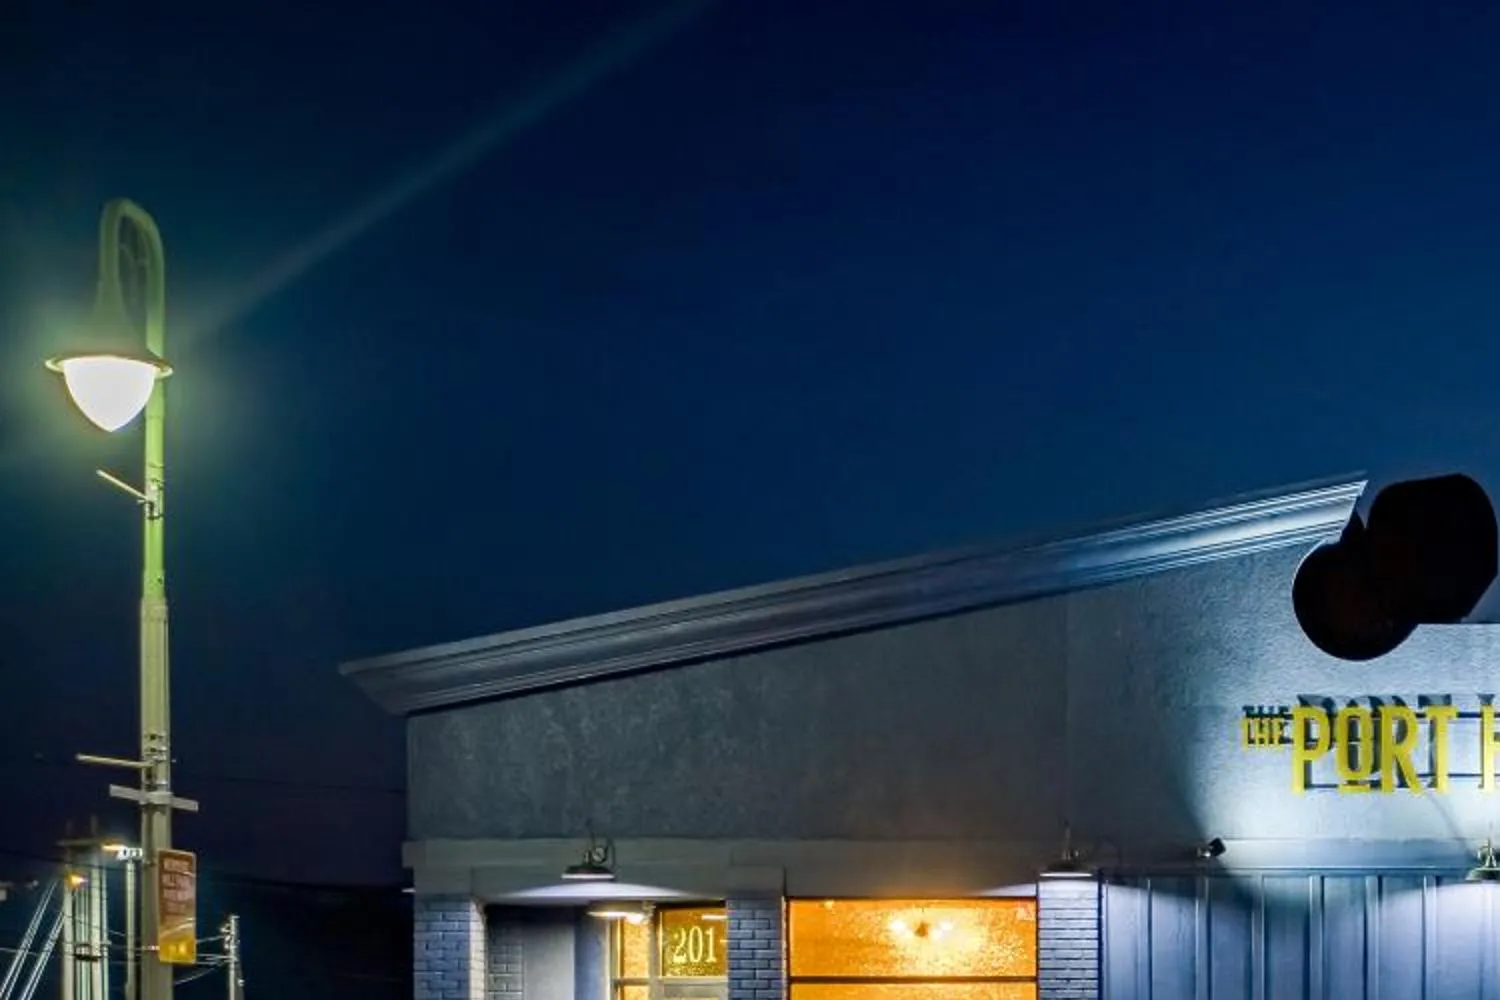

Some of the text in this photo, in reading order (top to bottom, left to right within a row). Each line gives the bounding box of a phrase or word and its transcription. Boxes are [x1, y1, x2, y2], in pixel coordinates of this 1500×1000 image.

[1241, 716, 1288, 751] THE
[1291, 704, 1459, 795] PORT
[672, 926, 717, 963] 201
